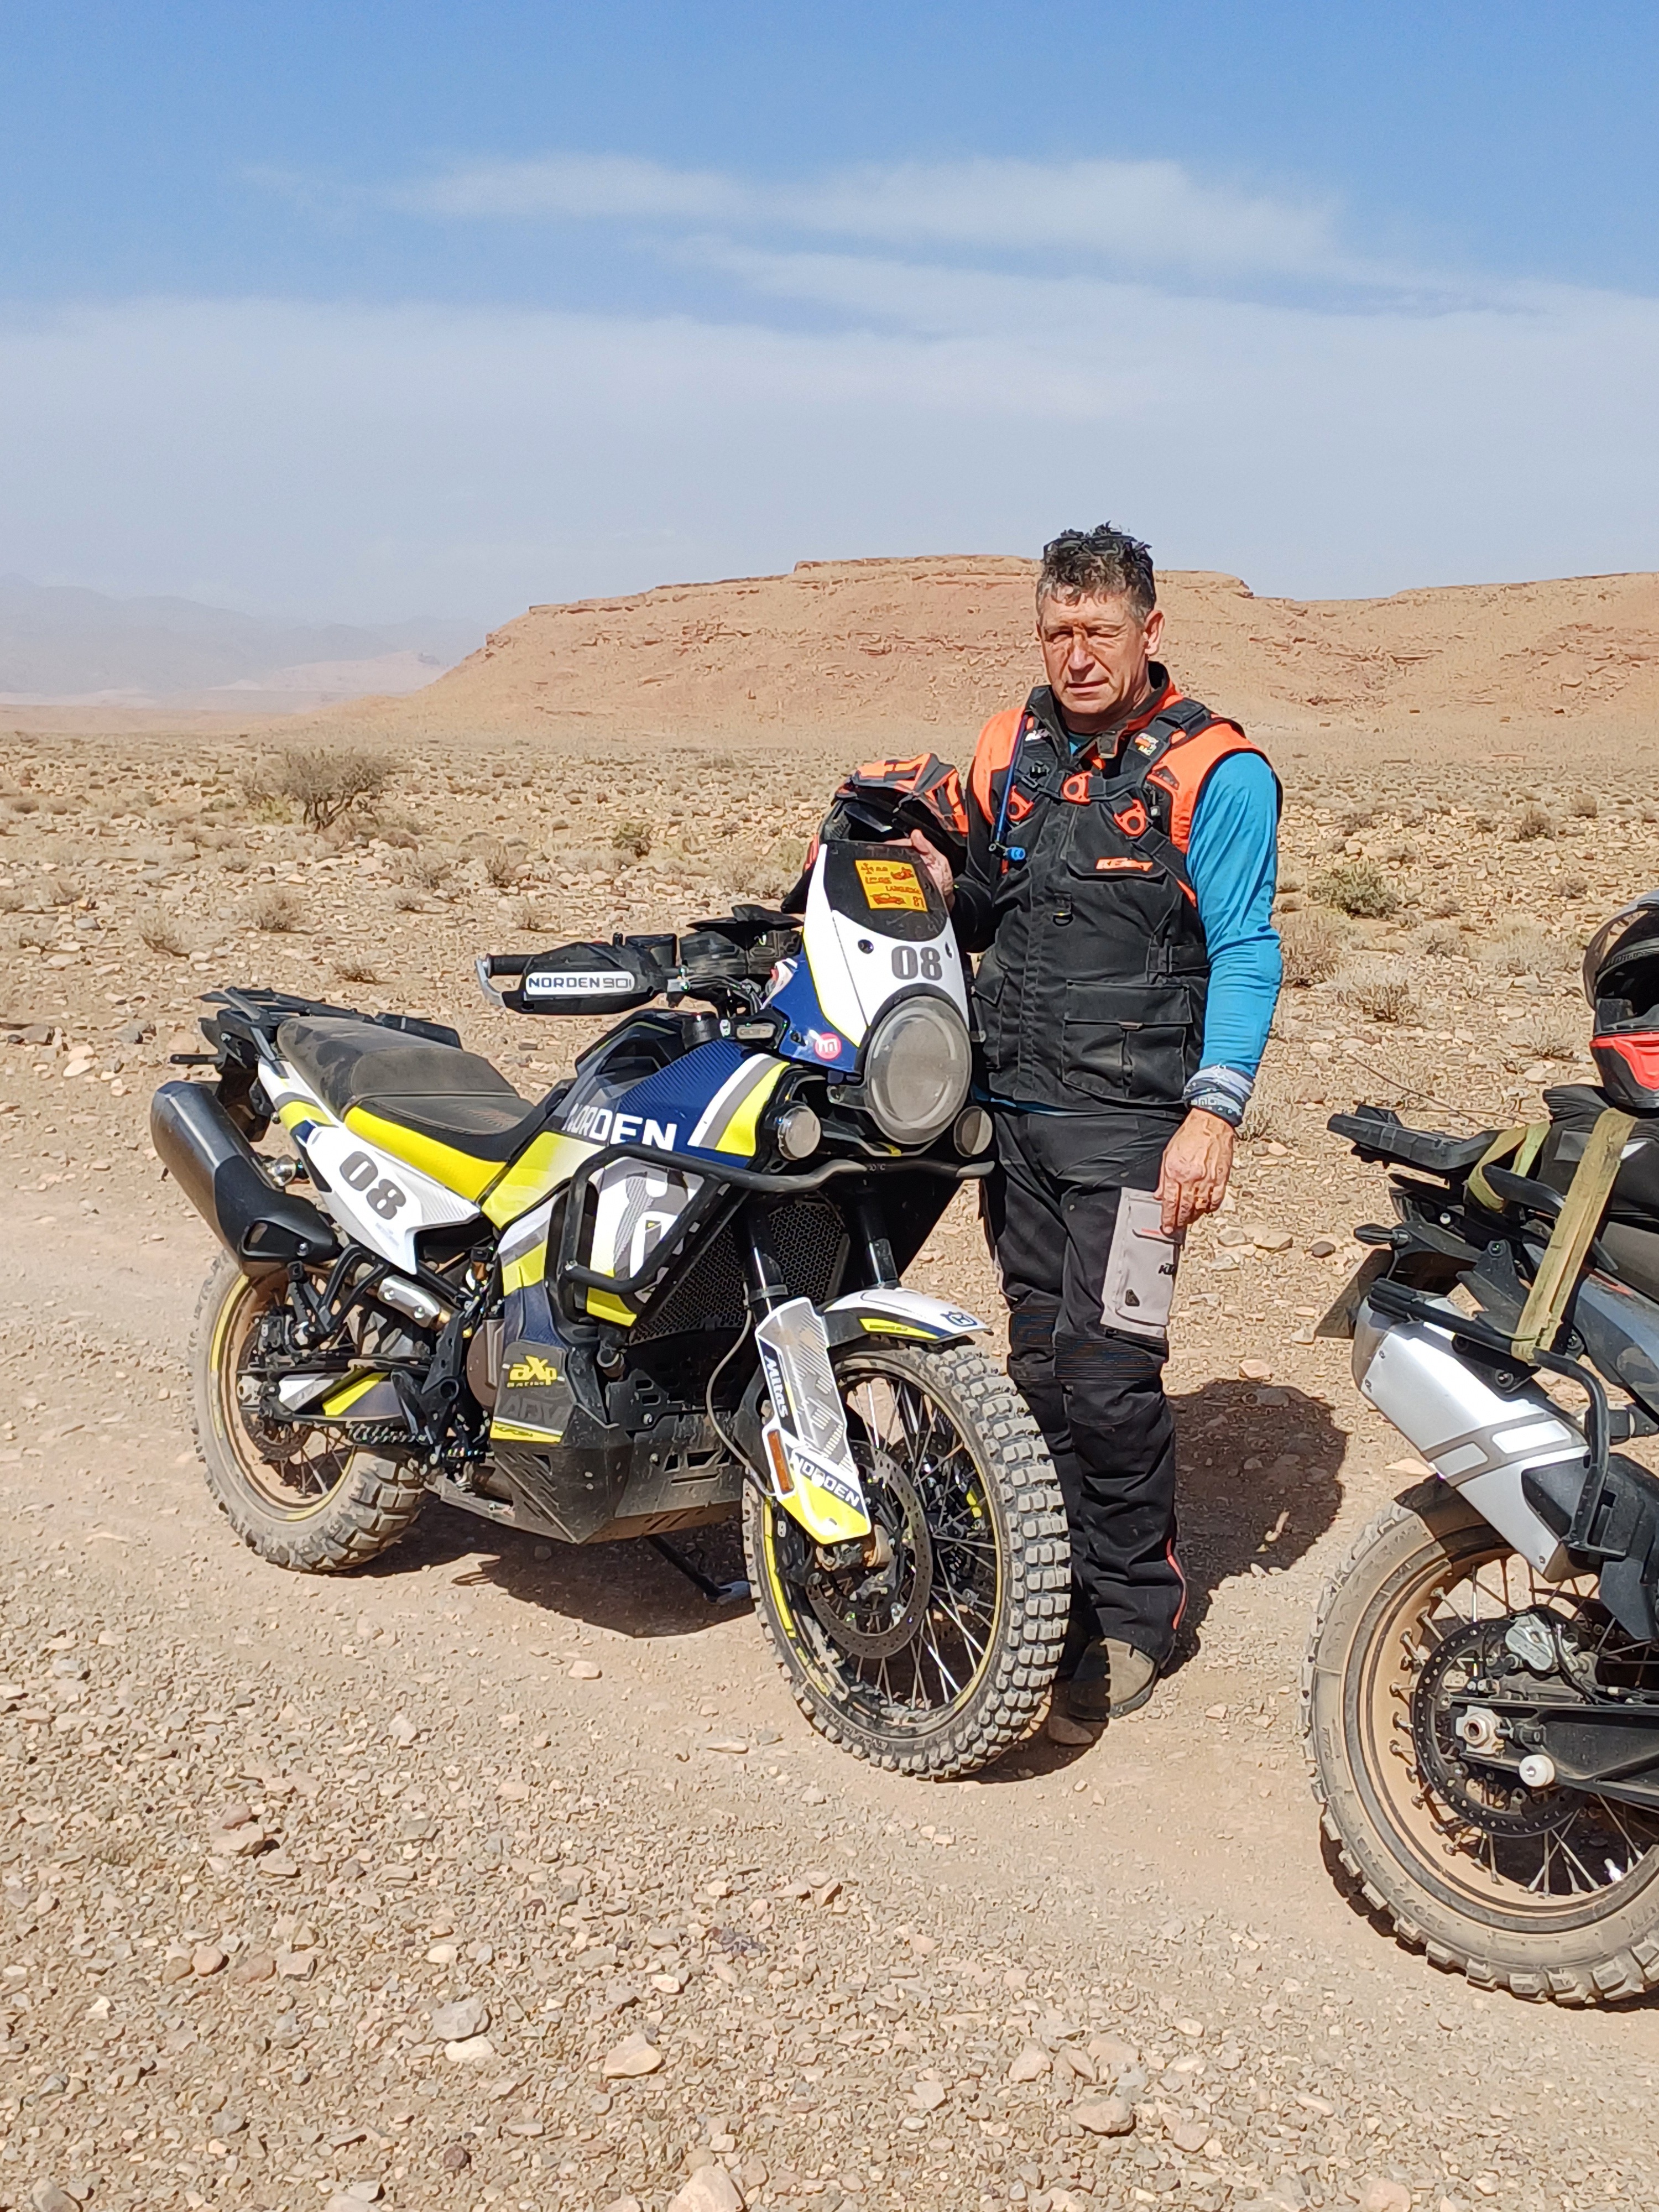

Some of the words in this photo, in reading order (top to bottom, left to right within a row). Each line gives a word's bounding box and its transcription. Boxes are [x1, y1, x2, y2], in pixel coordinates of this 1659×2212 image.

[529, 977, 600, 988] NORDEN
[603, 977, 632, 989] 901
[891, 945, 943, 981] 08
[561, 1102, 677, 1151] NORDEN
[339, 1151, 406, 1220] 08
[794, 1454, 860, 1508] NODEN
